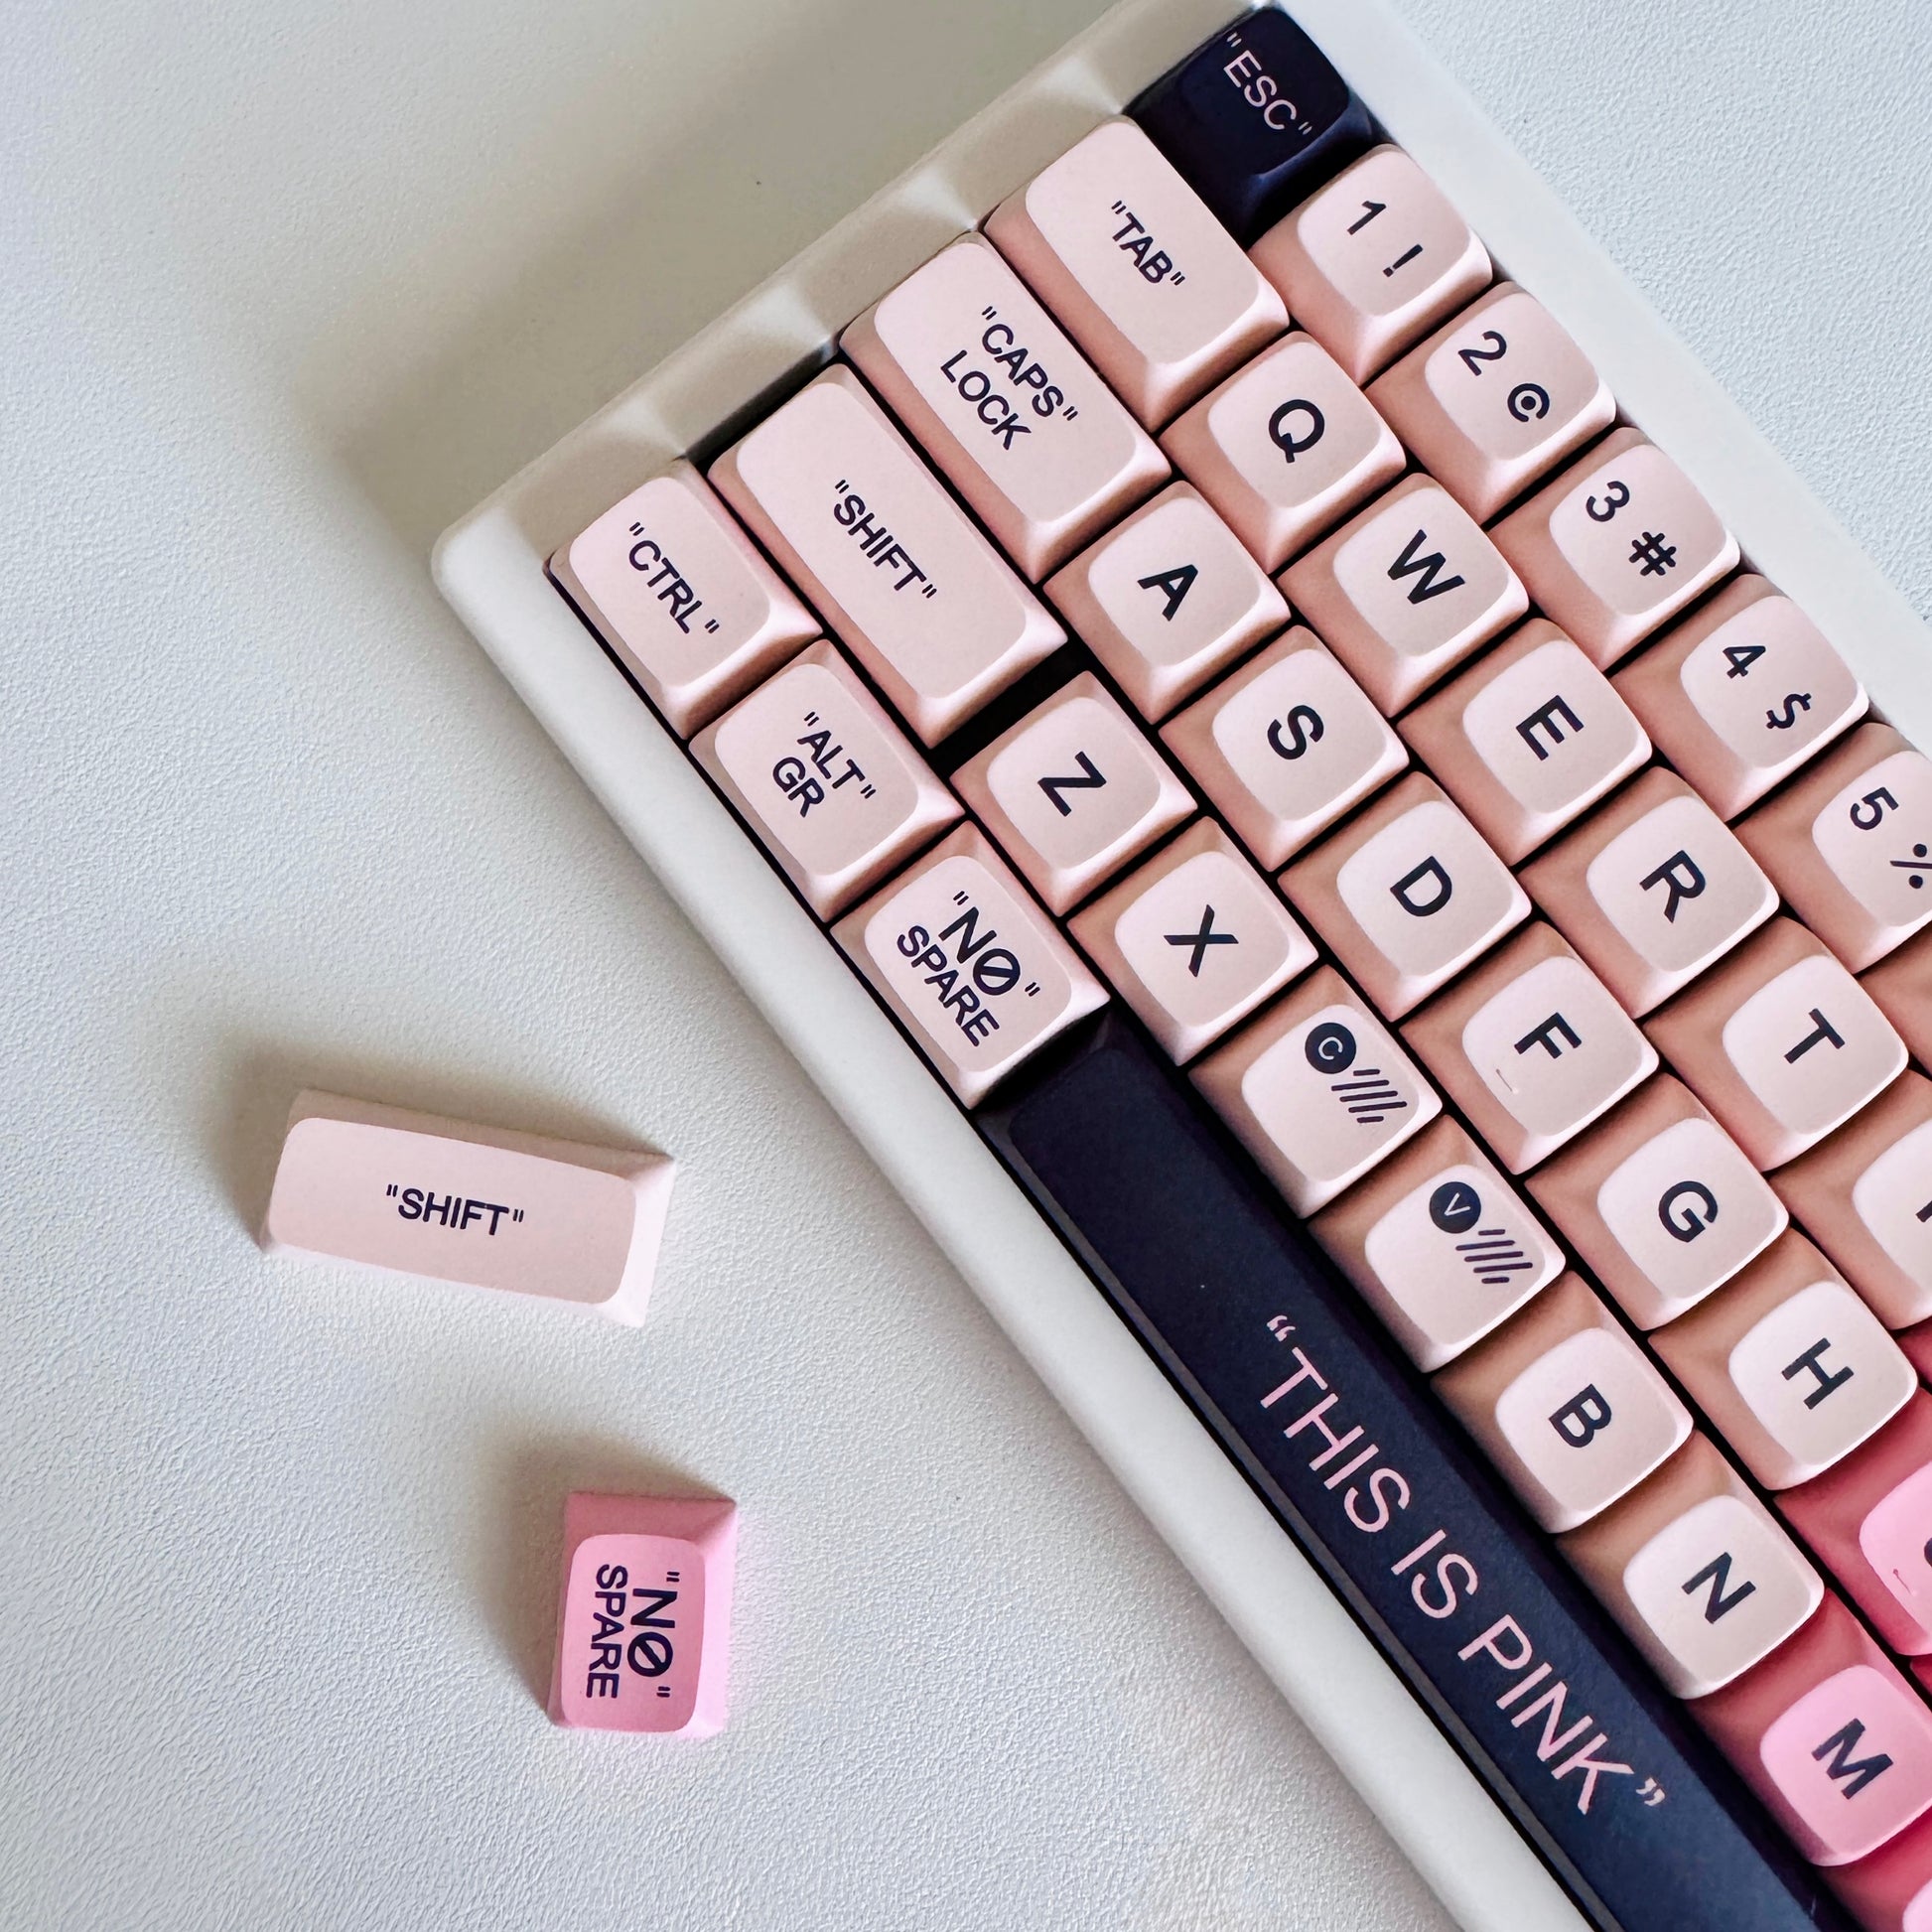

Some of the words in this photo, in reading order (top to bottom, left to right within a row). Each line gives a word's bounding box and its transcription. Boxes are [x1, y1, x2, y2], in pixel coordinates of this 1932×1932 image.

[1223, 33, 1312, 135] "ESC"
[1111, 200, 1185, 286] "TAB"
[1347, 201, 1387, 235] 1
[1382, 243, 1424, 278] !
[980, 305, 1079, 423] "CAPS"
[1457, 331, 1507, 376] 2
[939, 350, 1031, 451] LOCK
[1268, 398, 1325, 464] Q
[833, 479, 938, 600] "SHIFT"
[1586, 481, 1630, 522] 3
[1628, 531, 1677, 577] #
[628, 521, 720, 634] "CTRL"
[1137, 564, 1199, 621] A
[1387, 529, 1466, 605] W
[1722, 645, 1766, 679] 4
[1765, 692, 1812, 730] $
[795, 711, 877, 800] "ALT"
[1267, 704, 1324, 760] S
[1515, 694, 1585, 761] E
[771, 756, 826, 817] GR
[1036, 751, 1107, 817] Z
[1850, 786, 1899, 831] 5
[1389, 855, 1452, 917] D
[1639, 850, 1706, 923] R
[1164, 903, 1239, 978] X
[897, 925, 1000, 1047] SPARE
[1513, 1012, 1583, 1059] F
[1784, 1008, 1846, 1064] T
[386, 1183, 524, 1236] "SHIFT"
[1658, 1180, 1719, 1243] G
[1781, 1337, 1855, 1410] H
[1548, 1383, 1612, 1449] B
[1391, 1529, 1479, 1619] IS
[1681, 1552, 1756, 1624] N
[586, 1564, 627, 1699] SPARE
[1812, 1718, 1894, 1800] M
